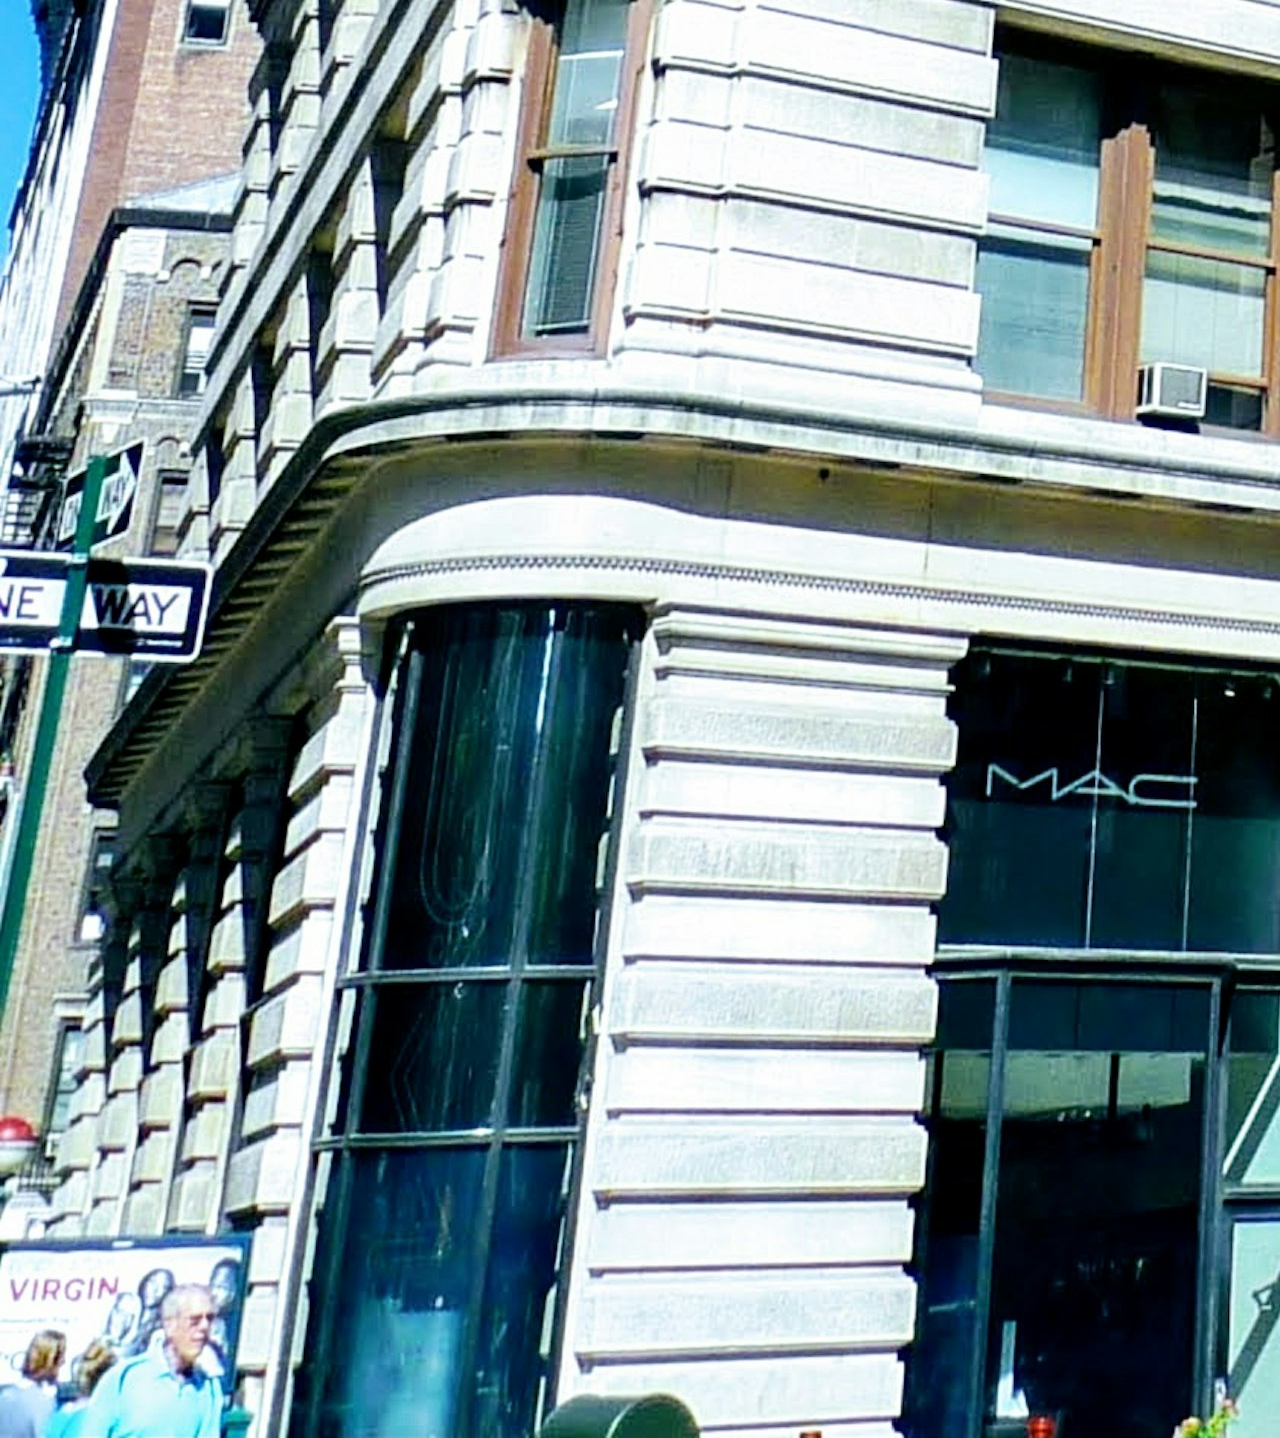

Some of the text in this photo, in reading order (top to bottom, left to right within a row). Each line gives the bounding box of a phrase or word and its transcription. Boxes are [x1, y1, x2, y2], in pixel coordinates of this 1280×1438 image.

[95, 583, 180, 626] WAY
[986, 763, 1198, 808] MAC
[10, 1276, 119, 1302] VIRGIN
